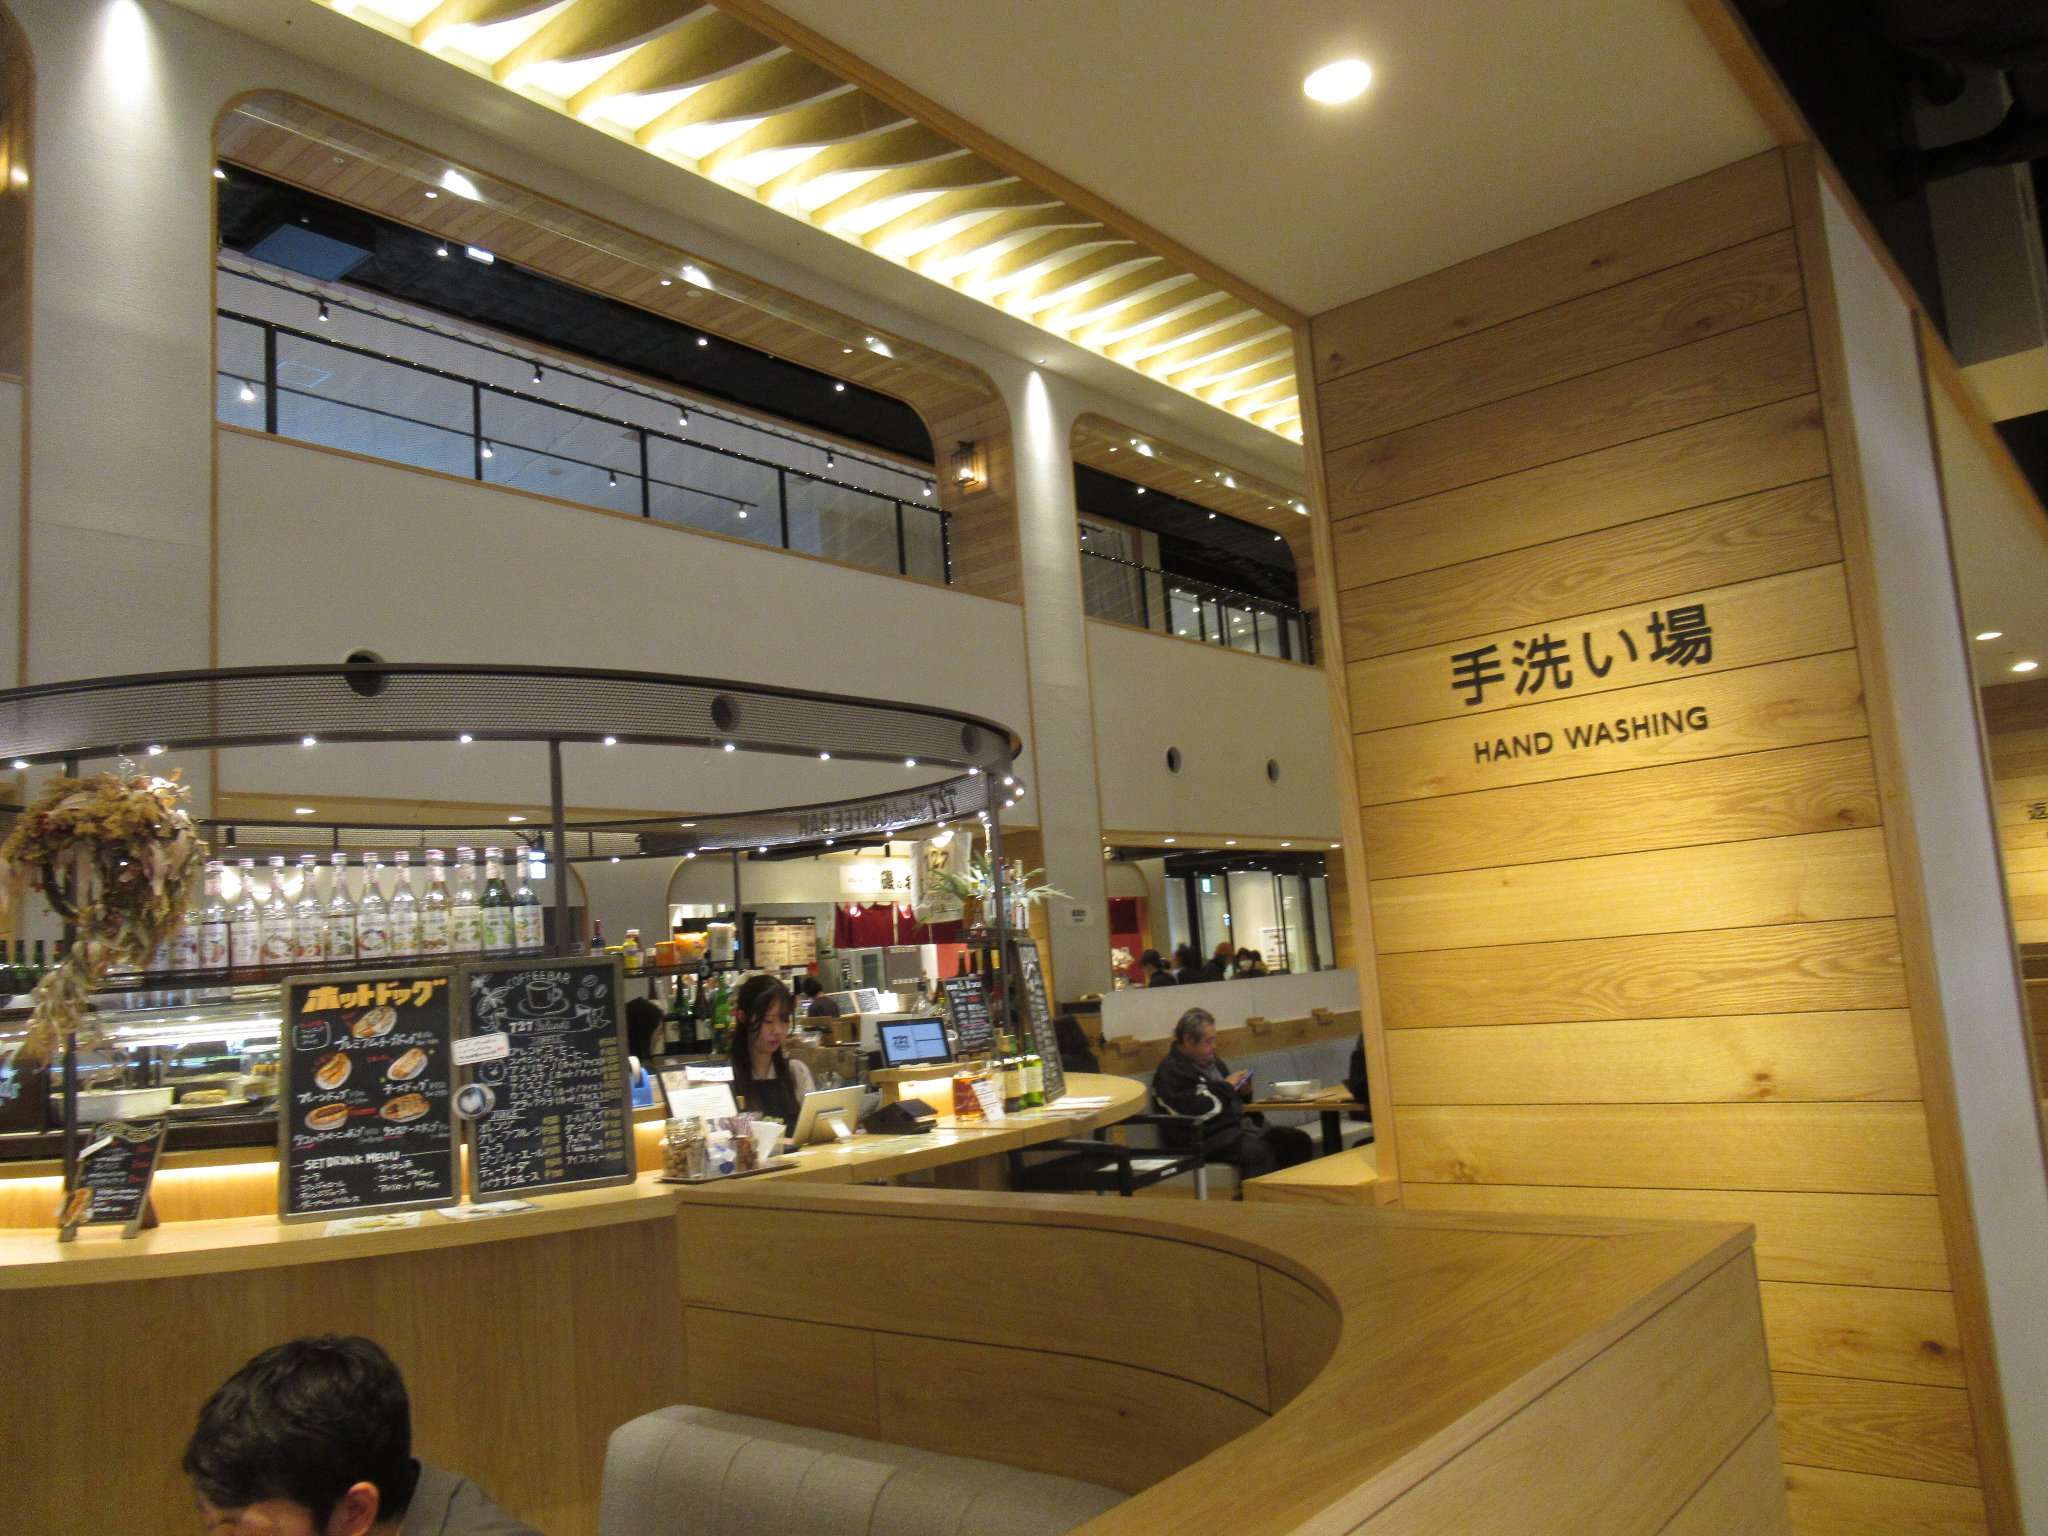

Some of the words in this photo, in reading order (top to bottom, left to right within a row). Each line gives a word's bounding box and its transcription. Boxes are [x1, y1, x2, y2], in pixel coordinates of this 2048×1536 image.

[1451, 604, 1712, 705] 手洗い場
[1474, 732, 1553, 763] HAND
[1564, 706, 1708, 749] WASHING
[302, 978, 448, 1013] ホットドッグ
[506, 970, 546, 986] COFFEE
[304, 1159, 325, 1171] SET
[365, 1150, 401, 1164] MENU
